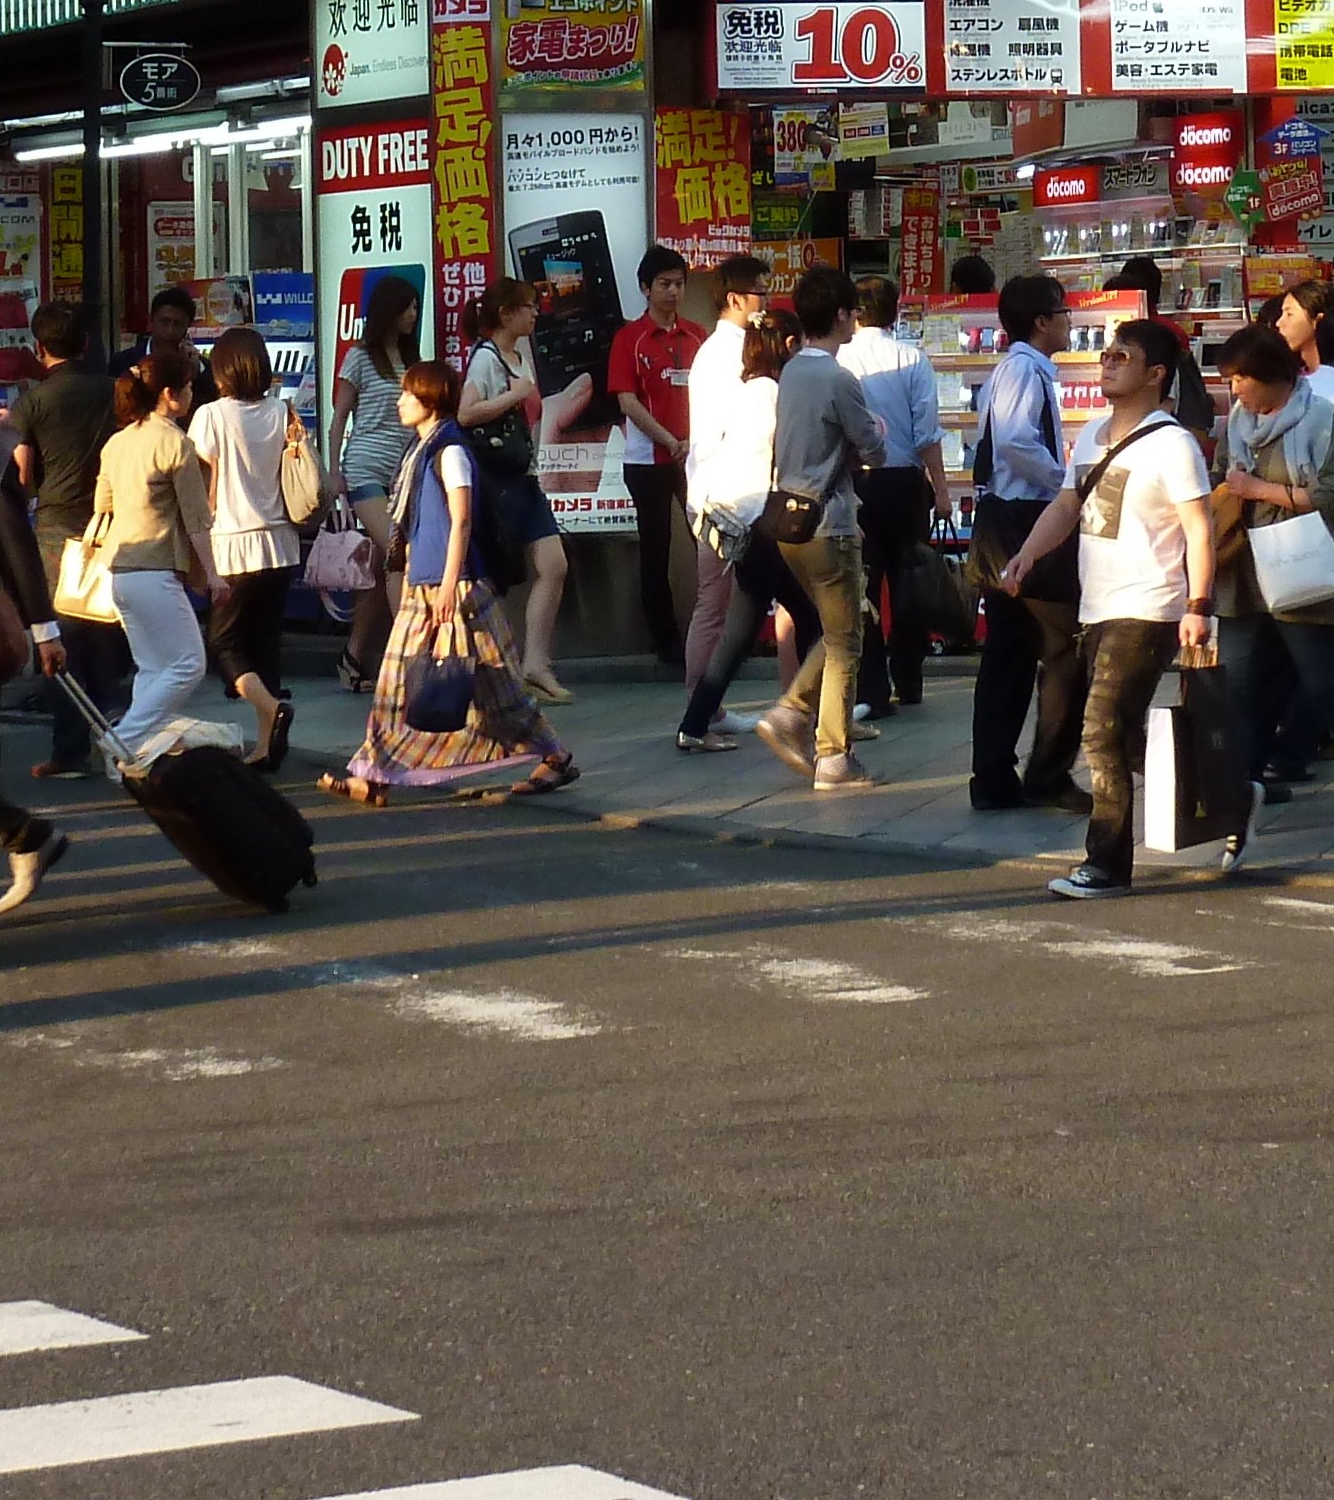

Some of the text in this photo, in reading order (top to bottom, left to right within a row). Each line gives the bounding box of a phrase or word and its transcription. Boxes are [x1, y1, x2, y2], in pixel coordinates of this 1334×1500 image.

[1114, 0, 1148, 12] iPod
[724, 7, 784, 39] 免税
[949, 17, 1059, 32] エアコン 扇風機
[1115, 19, 1169, 33] ゲーム機
[1278, 22, 1312, 35] DPE
[507, 15, 640, 66] 家電まつり!
[724, 40, 783, 53] 欢迎光临
[791, 6, 922, 84] 10%
[1115, 40, 1210, 54] ポータブルナビ
[1008, 42, 1063, 56] 照明器具
[1280, 44, 1334, 58] 携帯電話
[141, 63, 179, 79] モア
[350, 58, 398, 78] Japan. Endless
[951, 68, 1047, 82] ステンレスボトル
[1280, 67, 1308, 81] 電池
[1179, 128, 1232, 146] docomo
[322, 128, 430, 181] DUTY FREE
[1104, 164, 1157, 188] スマートフォン
[674, 163, 751, 225] 価格
[1047, 177, 1085, 198] docomo
[1248, 196, 1261, 209] 1F
[1271, 191, 1319, 216] docomo
[350, 201, 402, 254] 免税
